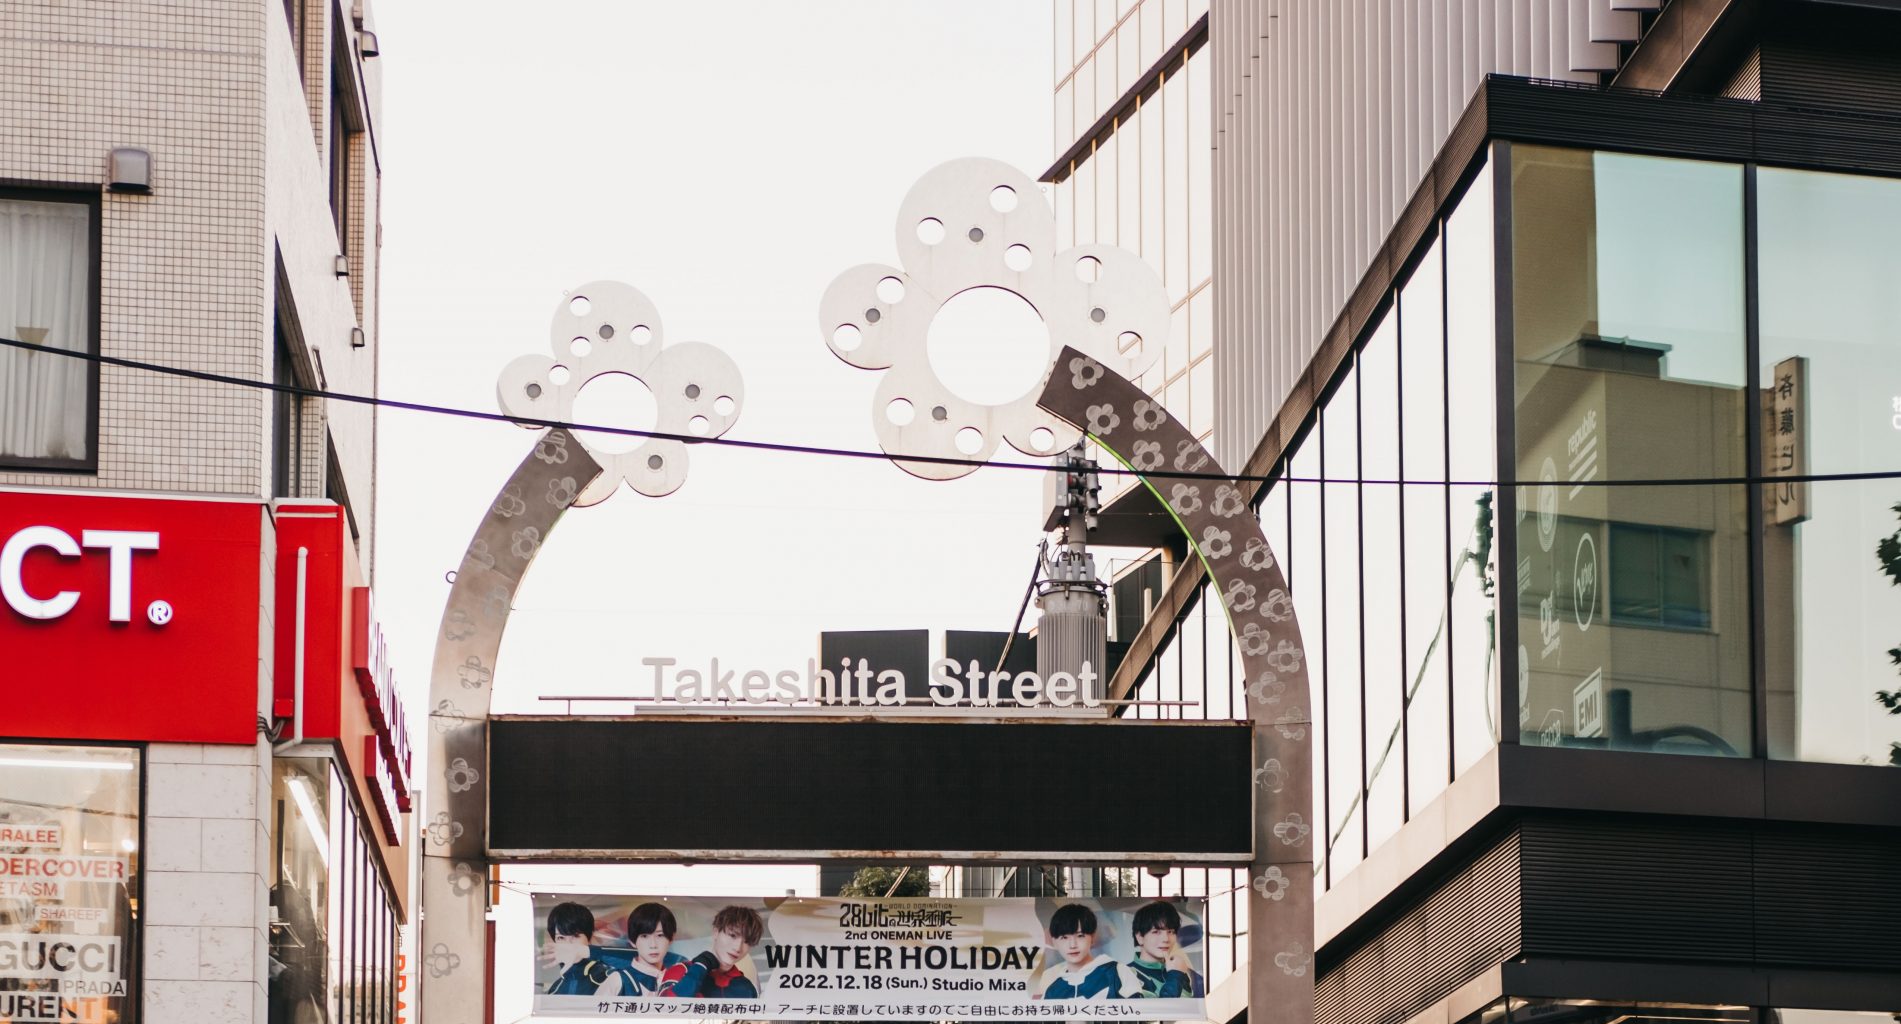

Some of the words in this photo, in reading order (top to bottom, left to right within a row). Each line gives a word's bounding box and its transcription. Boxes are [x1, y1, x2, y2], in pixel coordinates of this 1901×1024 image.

[642, 656, 906, 706] Takeshita
[929, 657, 1101, 708] Street
[1578, 690, 1599, 732] EMI
[845, 930, 868, 940] 2nd
[870, 930, 923, 940] ONEMAN
[926, 930, 953, 940] LIVE
[0, 940, 116, 973] GUCCI
[765, 945, 893, 970] WINTER
[899, 945, 1041, 970] HOLIDAY
[63, 980, 125, 995] PRADA
[779, 974, 883, 990] 2022.12.18
[932, 978, 984, 991] Studio
[988, 979, 1027, 991] Mixa
